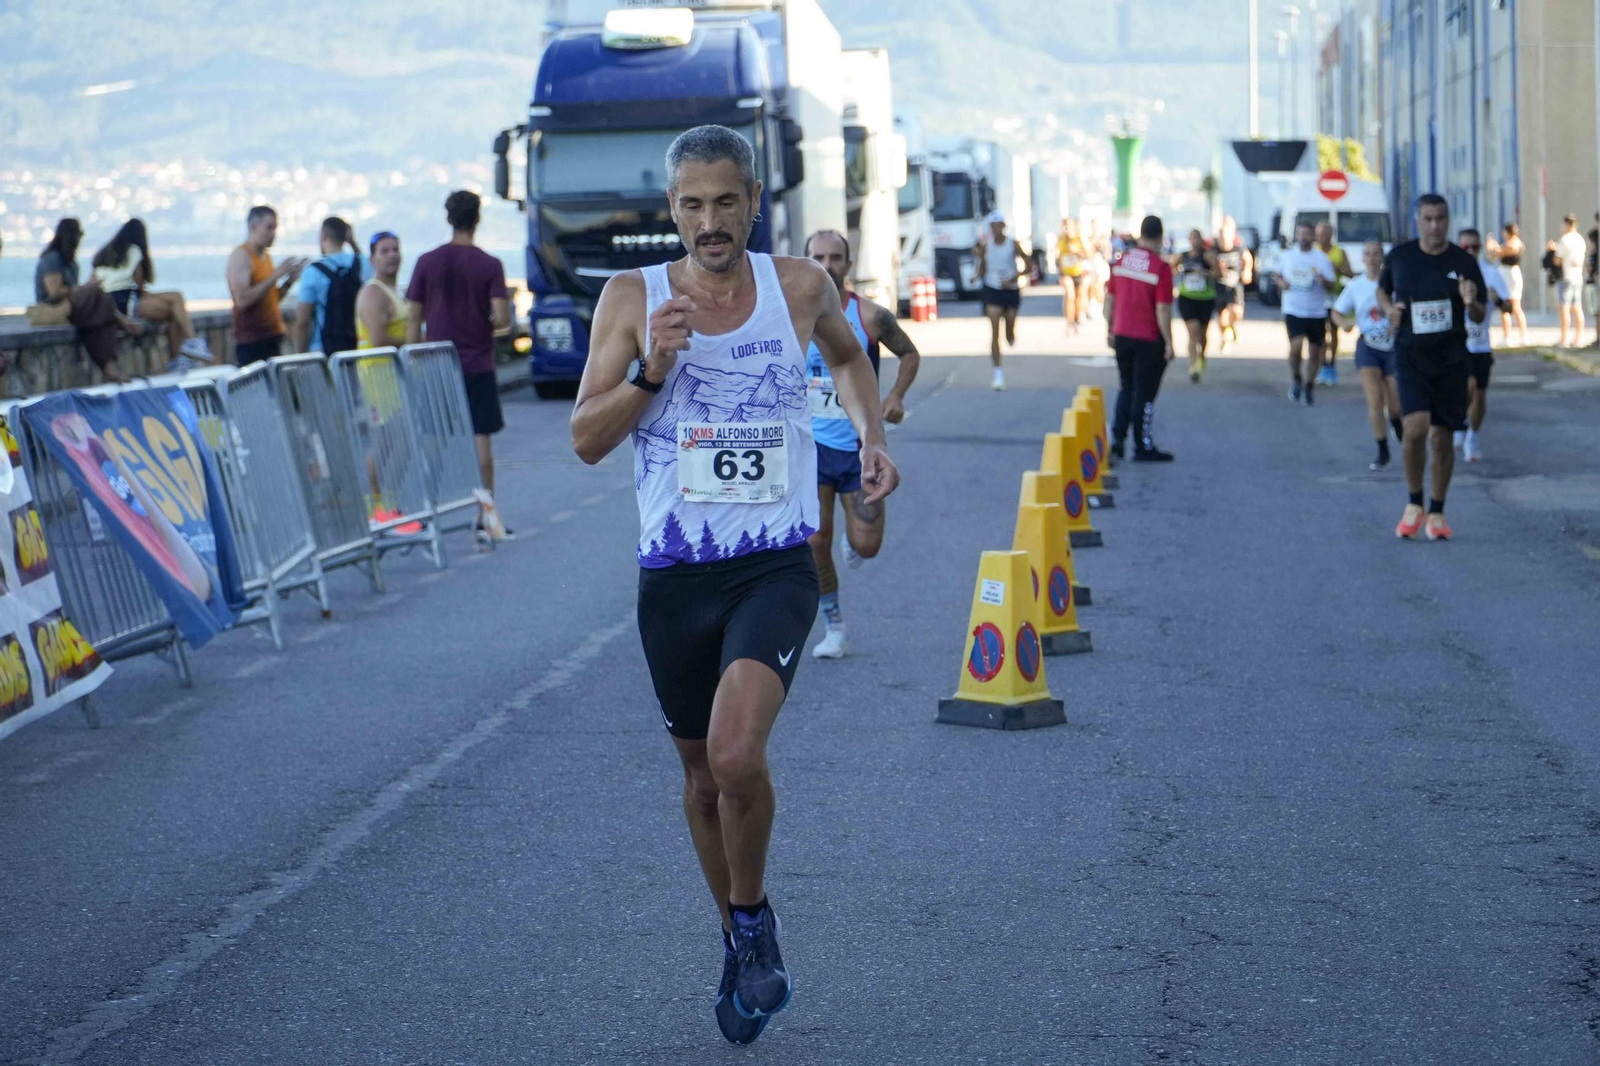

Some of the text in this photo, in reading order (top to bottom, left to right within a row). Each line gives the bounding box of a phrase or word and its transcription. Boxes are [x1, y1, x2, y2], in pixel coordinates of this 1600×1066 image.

[611, 234, 681, 251] IVECO
[731, 339, 783, 359] LODEIROS
[683, 426, 784, 440] 10KMS ALFONSO MORO
[713, 449, 766, 482] 63
